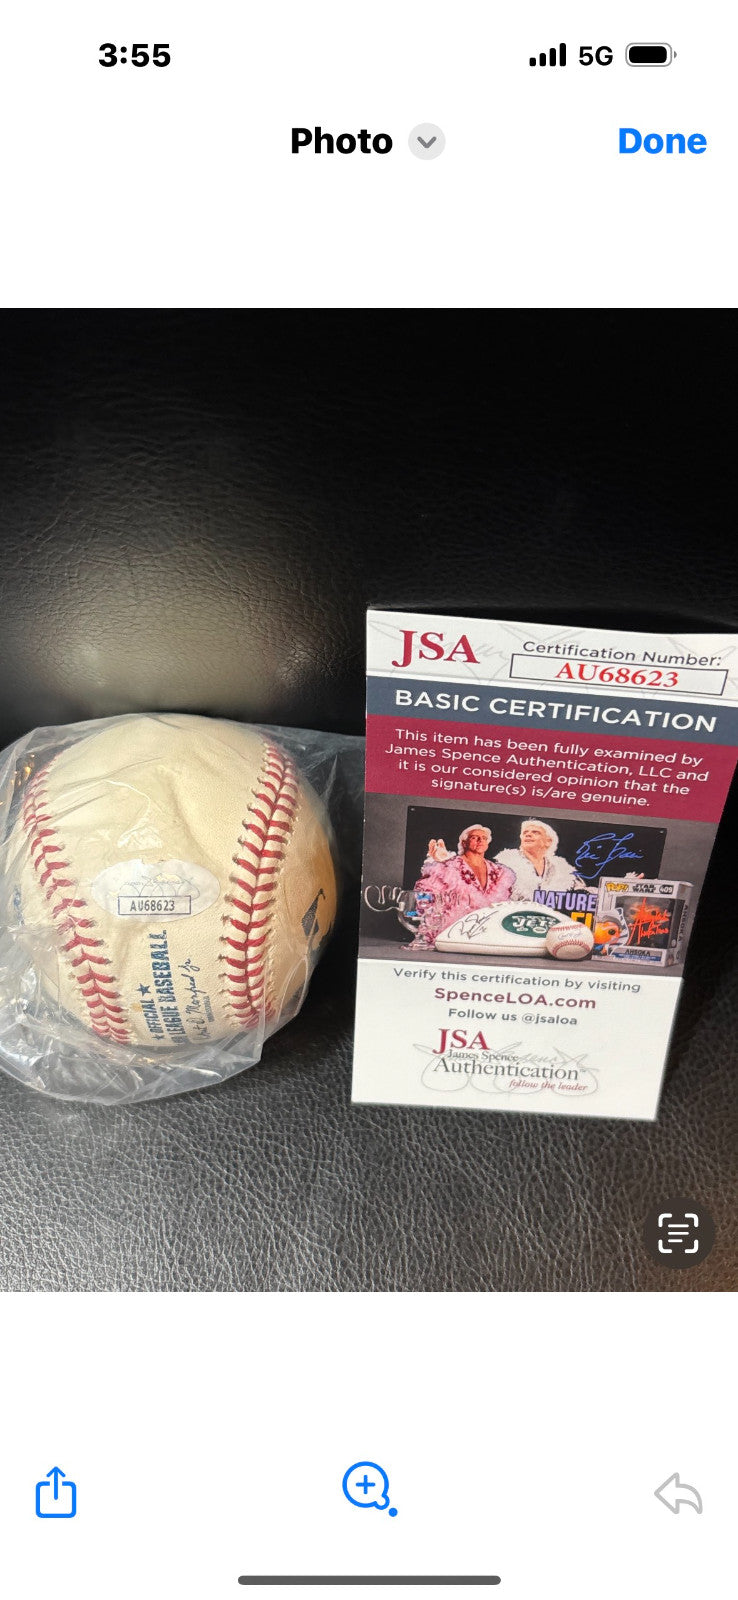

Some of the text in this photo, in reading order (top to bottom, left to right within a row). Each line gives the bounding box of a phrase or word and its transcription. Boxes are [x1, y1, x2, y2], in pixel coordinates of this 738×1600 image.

[98, 42, 172, 68] 3:55
[578, 45, 614, 67] 5G
[291, 126, 394, 155] Photo
[618, 127, 708, 155] Done
[392, 629, 481, 668] JSA
[523, 640, 722, 667] Certification Number:
[555, 662, 679, 688] AU68623
[394, 689, 717, 733] BASIC CERTIFICATION
[395, 728, 704, 768] This item has been fully examined by
[385, 743, 709, 782] James Spence Authentication, LLC and
[398, 759, 690, 796] it is our considered opinion that the
[431, 776, 651, 807] signature(s) is/are genuine.
[129, 899, 176, 912] AU68623
[533, 889, 598, 911] NATURE
[148, 929, 177, 1003] BASEBALL
[393, 967, 642, 994] Verify this certification by visiting
[434, 987, 597, 1010] SpenceLOA.com
[140, 998, 164, 1034] OFFICIAL
[160, 1005, 187, 1036] LEAGUE
[448, 1007, 579, 1026] Follow us @jsaloa
[432, 1028, 491, 1055] JSA
[447, 1049, 519, 1063] James Spence
[508, 1078, 589, 1092] follow the leader
